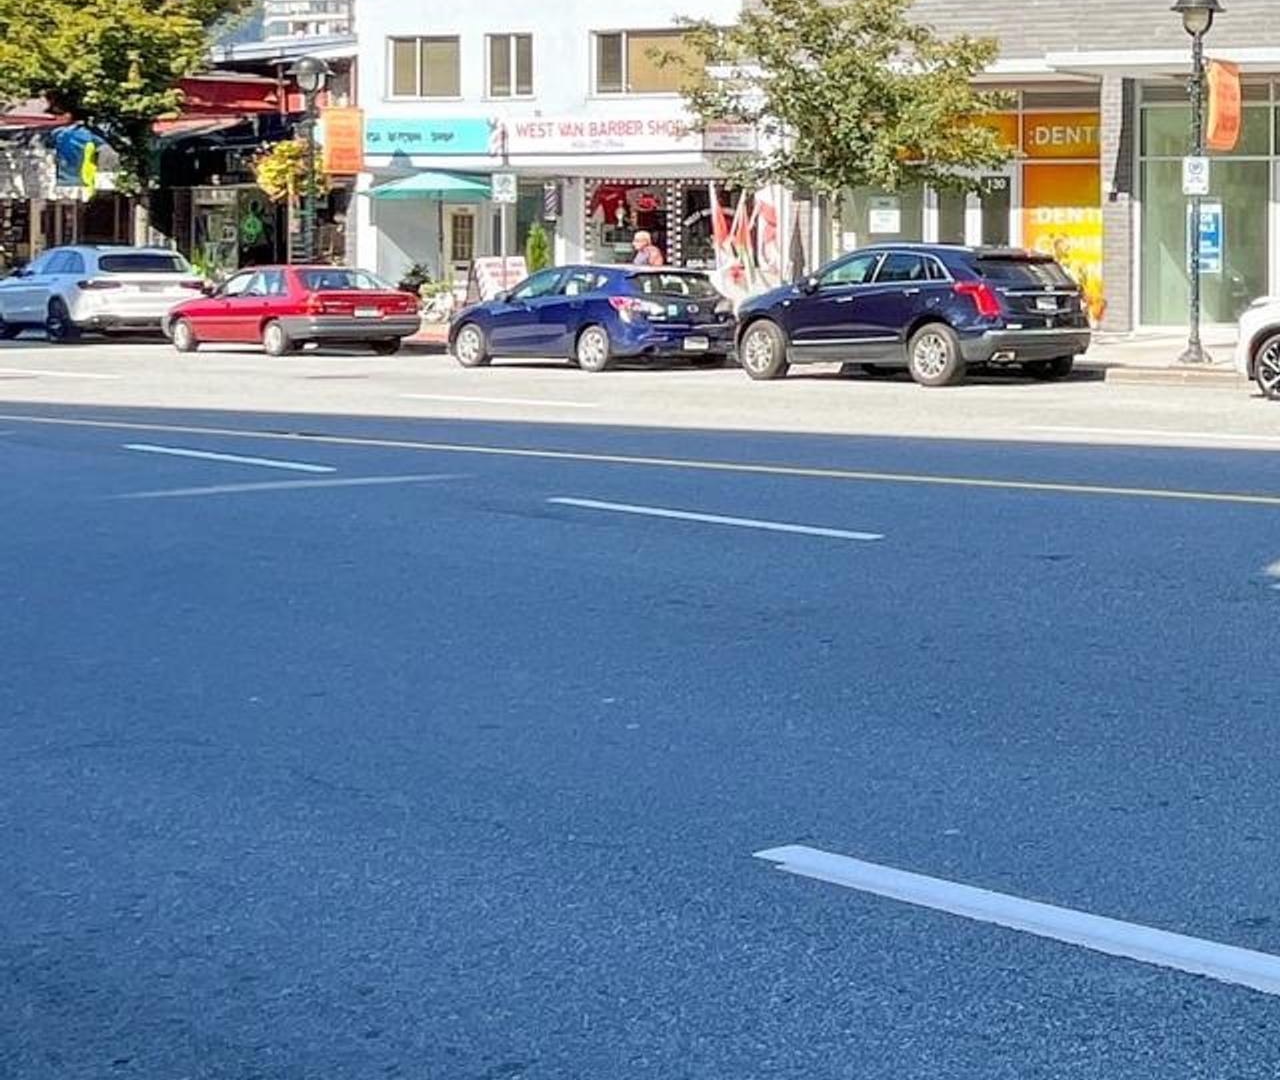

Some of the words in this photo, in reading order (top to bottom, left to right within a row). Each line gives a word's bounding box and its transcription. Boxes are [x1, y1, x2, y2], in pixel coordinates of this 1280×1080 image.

[515, 122, 555, 138] WEST
[557, 122, 584, 138] VAN
[588, 121, 644, 137] BARBER
